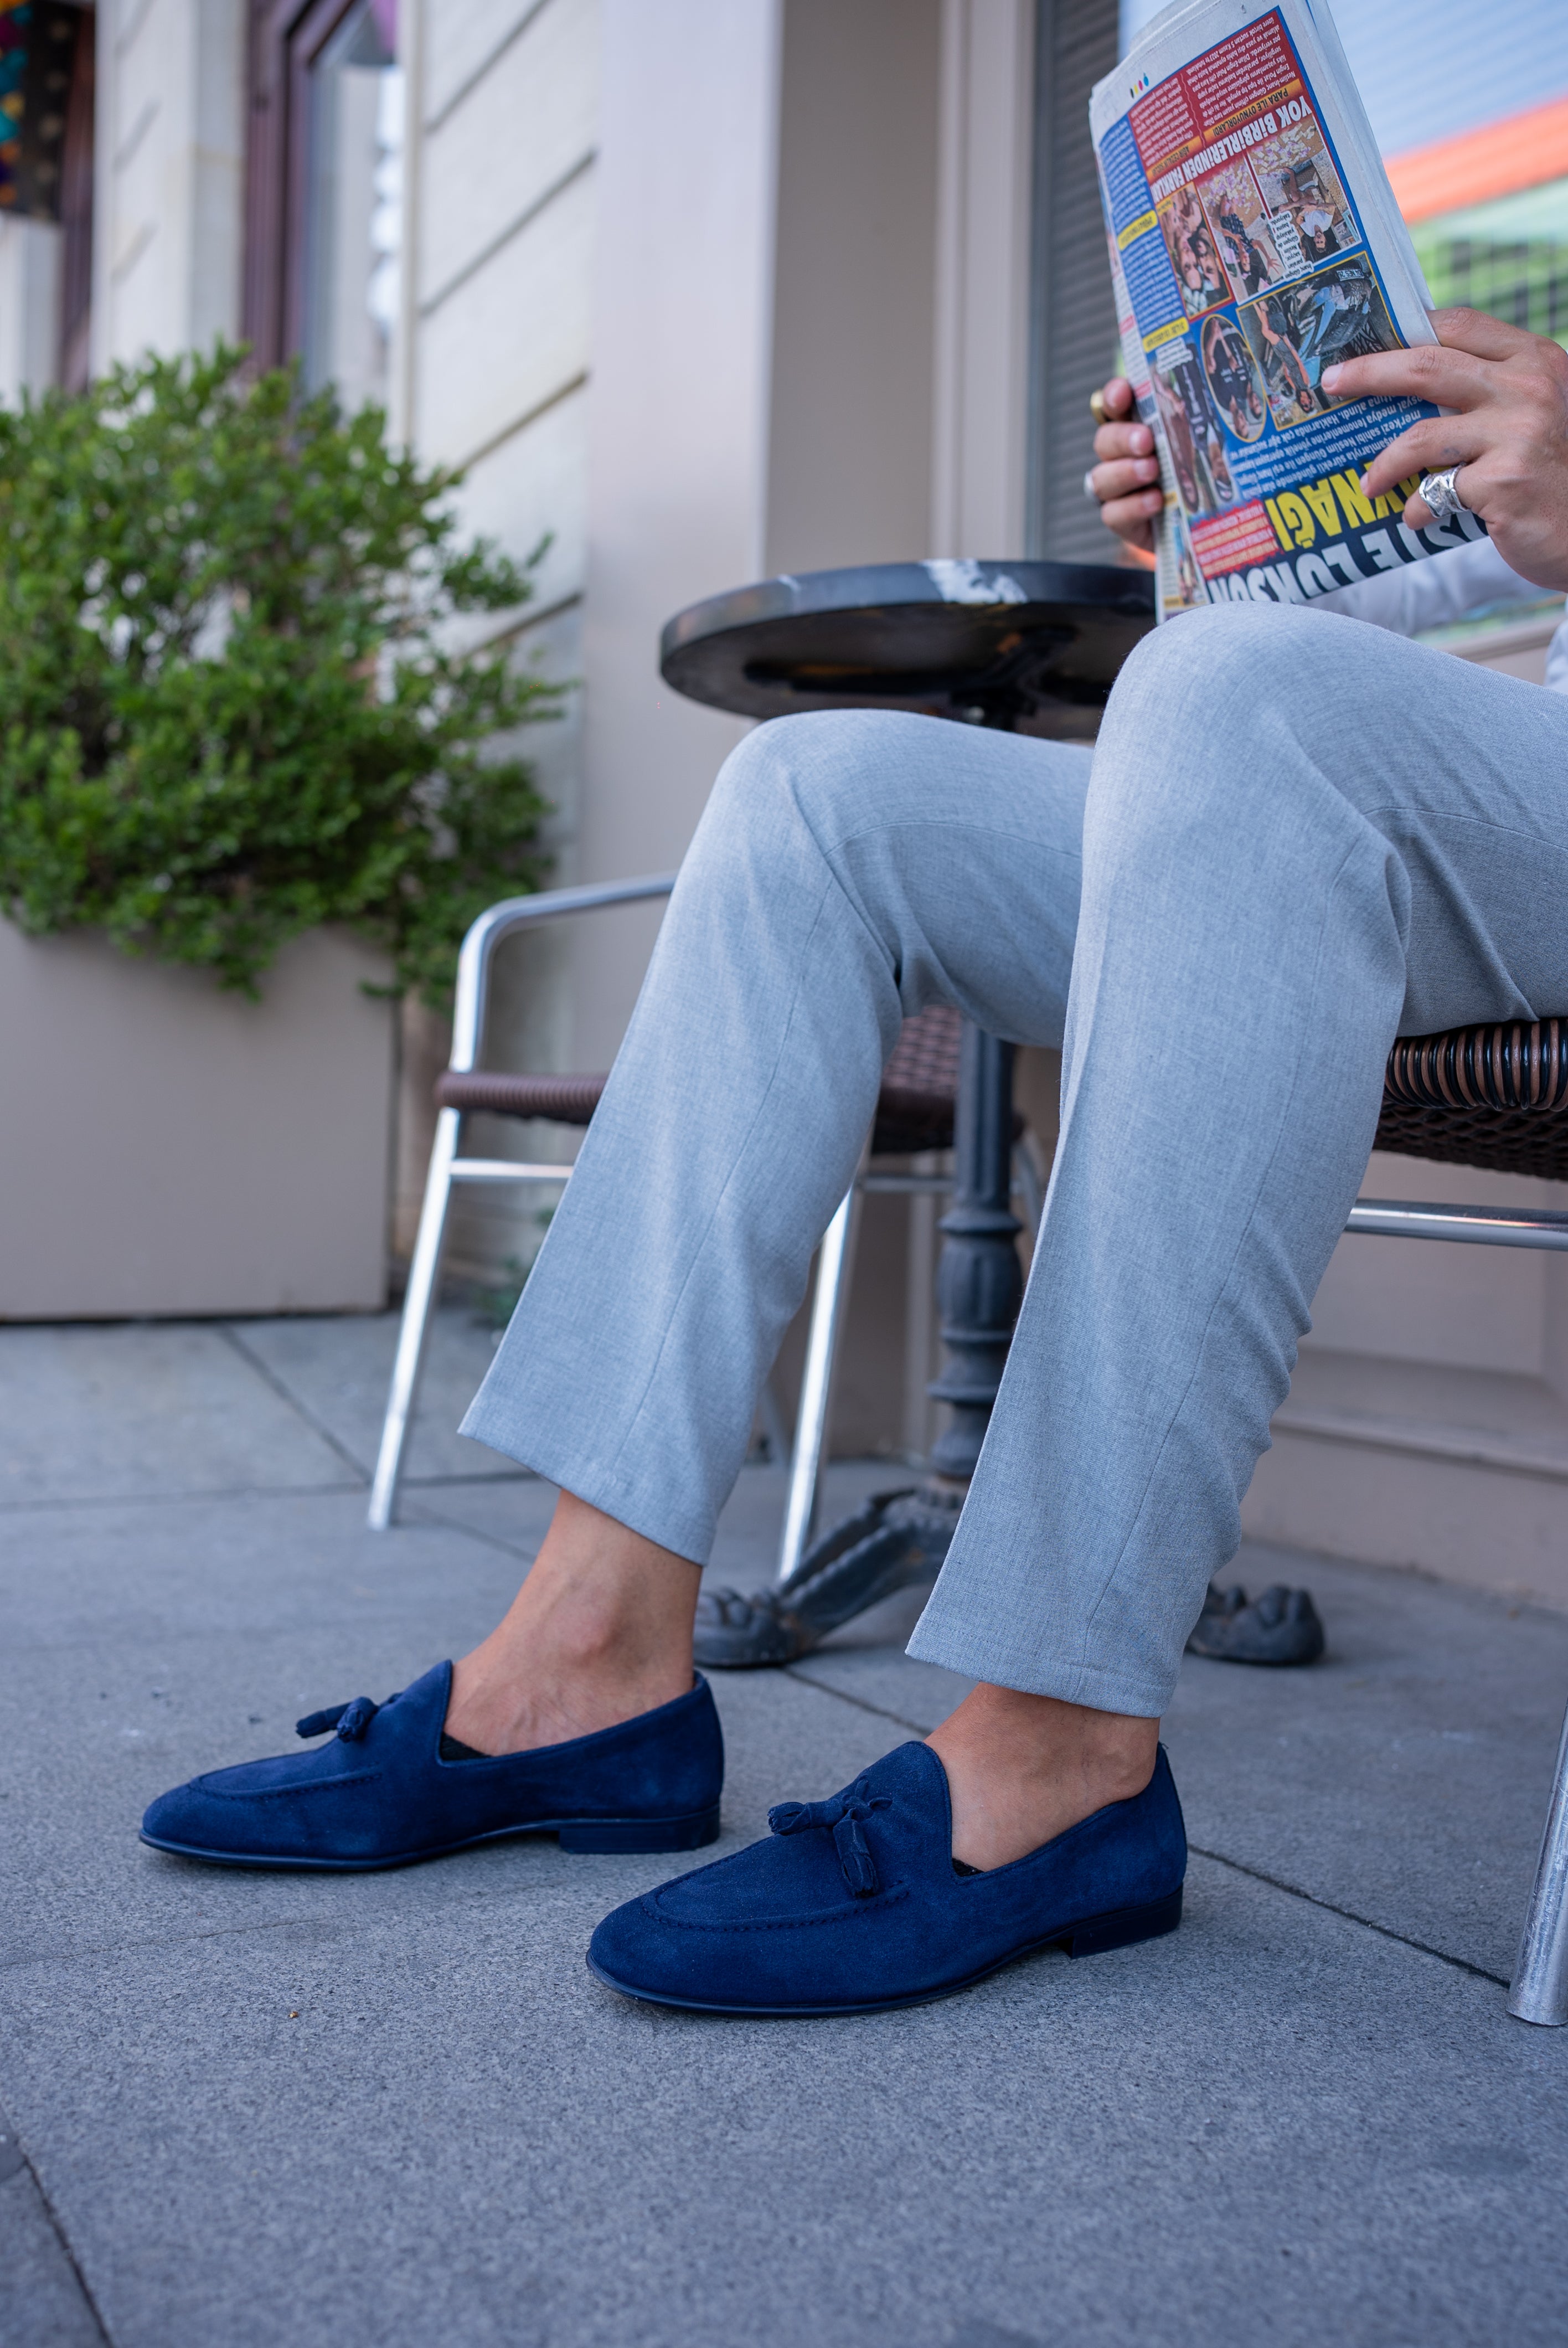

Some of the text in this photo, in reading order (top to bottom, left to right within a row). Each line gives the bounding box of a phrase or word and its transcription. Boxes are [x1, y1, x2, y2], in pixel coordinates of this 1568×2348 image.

[1249, 24, 1263, 36] birçok
[1262, 17, 1273, 27] üzere
[1234, 32, 1249, 44] suçtan
[1262, 24, 1279, 39] aklamak
[1219, 43, 1231, 54] Kasım
[1245, 37, 1256, 48] yasa
[1250, 40, 1272, 56] veriyordu.
[1235, 58, 1258, 75] paralardan
[1250, 58, 1276, 78] yaşamlarını
[1276, 63, 1289, 74] Engin
[1263, 71, 1276, 81] Polat
[1266, 71, 1295, 90] Neslim-İnanç
[1249, 87, 1266, 99] Güngen
[1211, 87, 1288, 136] PARA İLE OYNUYORLARDI
[1275, 95, 1311, 124] YOK
[1180, 111, 1277, 182] BİRBİRLERİNDEN
[1338, 403, 1366, 419] alındı.
[1397, 395, 1422, 413] osyal
[1366, 405, 1396, 423] medya
[1381, 410, 1422, 434] merkezi
[1294, 415, 1339, 436] Haklarında
[1311, 418, 1366, 444] fenomenlerine
[1355, 428, 1380, 444] sahibi
[1284, 437, 1311, 456] yönelik
[1326, 437, 1356, 452] Neslim
[1285, 460, 1296, 468] ile
[1295, 449, 1327, 465] Güngen
[1317, 455, 1346, 472] sürekli
[1272, 464, 1284, 475] eşi
[1276, 465, 1316, 487] gündemde
